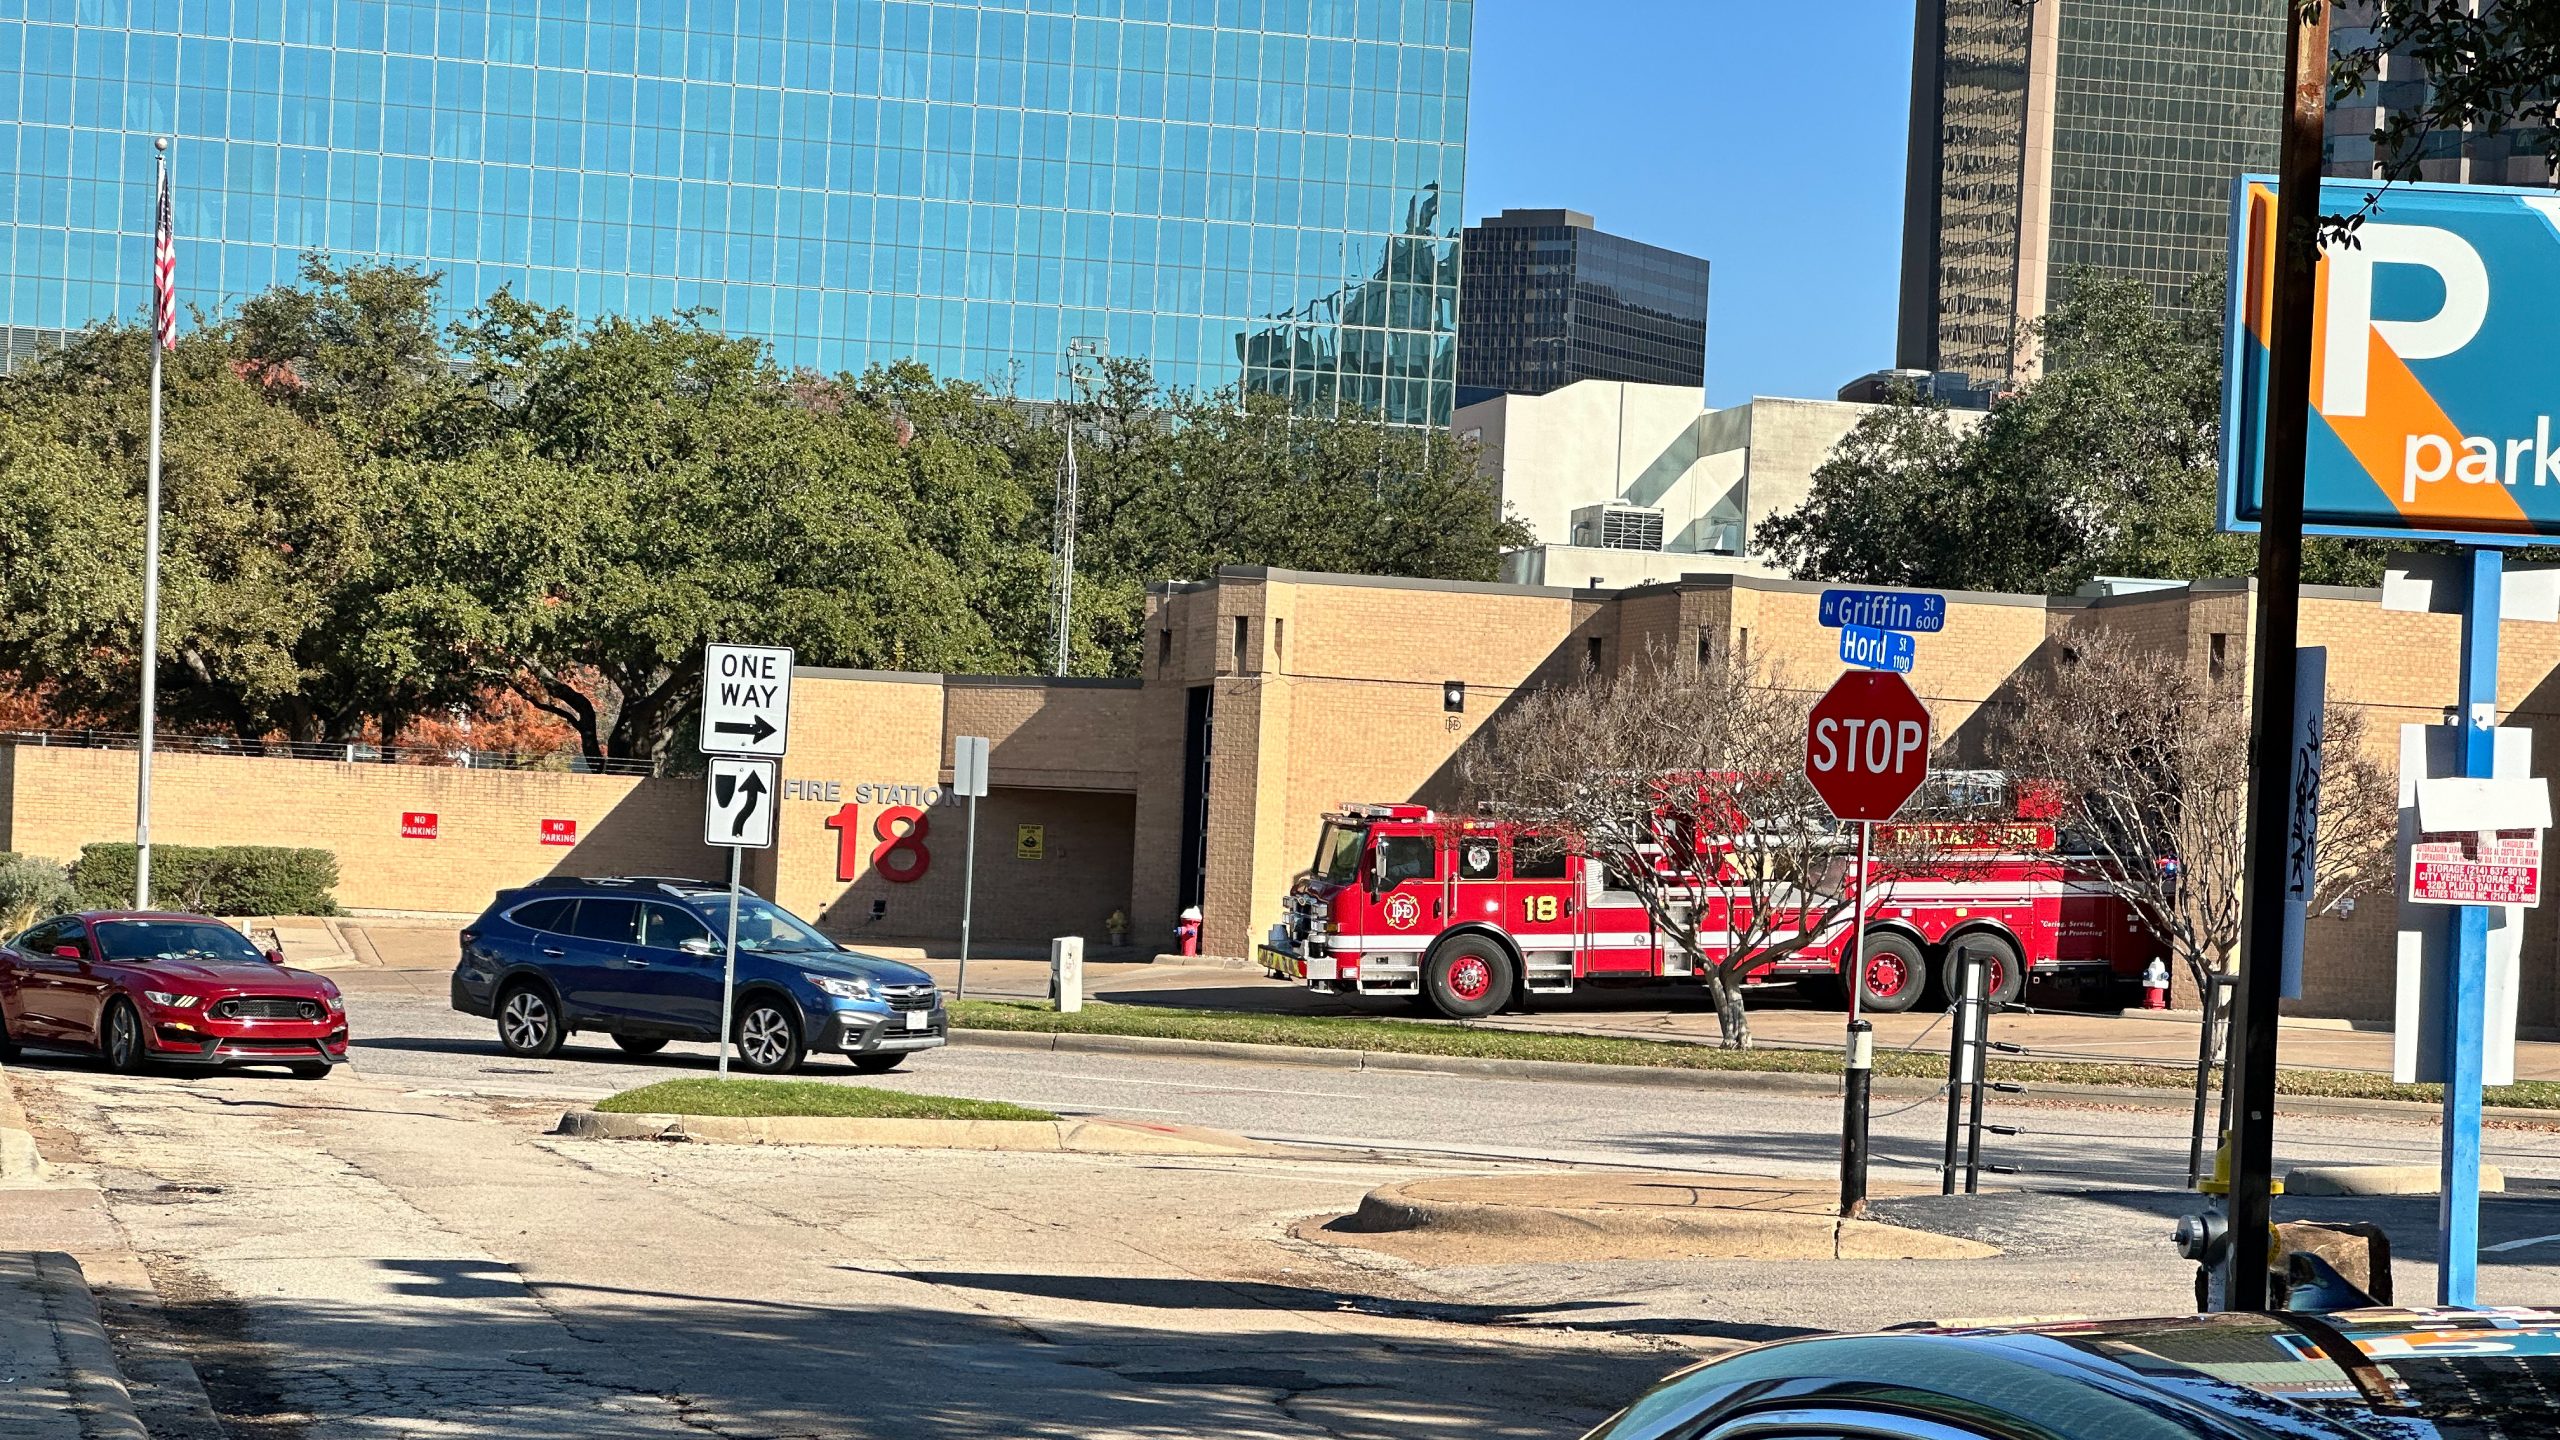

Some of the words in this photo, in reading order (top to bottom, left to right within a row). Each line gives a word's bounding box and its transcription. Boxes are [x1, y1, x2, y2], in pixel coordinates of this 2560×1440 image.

[2320, 223, 2490, 417] P
[1825, 602, 1834, 615] N
[1839, 595, 1912, 628] Griffin
[1923, 597, 1935, 612] St
[1915, 615, 1939, 630] 600
[1844, 630, 1888, 665] Hord
[1898, 637, 1908, 652] St
[721, 653, 776, 680] ONE
[1893, 655, 1910, 670] 1100
[721, 682, 779, 709] WAY
[1813, 717, 1923, 774] STOP
[784, 779, 841, 802] FIRE
[856, 783, 962, 808] STATION
[414, 815, 426, 824] NO
[552, 822, 564, 831] NO
[401, 826, 438, 836] PARKING
[540, 833, 576, 843] PARKING
[825, 803, 930, 883] 18
[2426, 863, 2465, 874] STORAGE
[2467, 865, 2488, 876] (214)
[2489, 866, 2528, 877] 637-9010
[2419, 871, 2438, 881] CITY
[2440, 872, 2474, 883] VEHICLE
[2476, 874, 2515, 885] STORAGE
[2516, 876, 2533, 886] INC.
[2414, 888, 2427, 898] ALL
[2428, 889, 2448, 899] CITIES
[2449, 890, 2475, 900] TOWING
[2476, 891, 2490, 900] INC.
[2448, 881, 2476, 891] PLUTO
[2514, 884, 2525, 894] TX
[1523, 895, 1558, 922] 18
